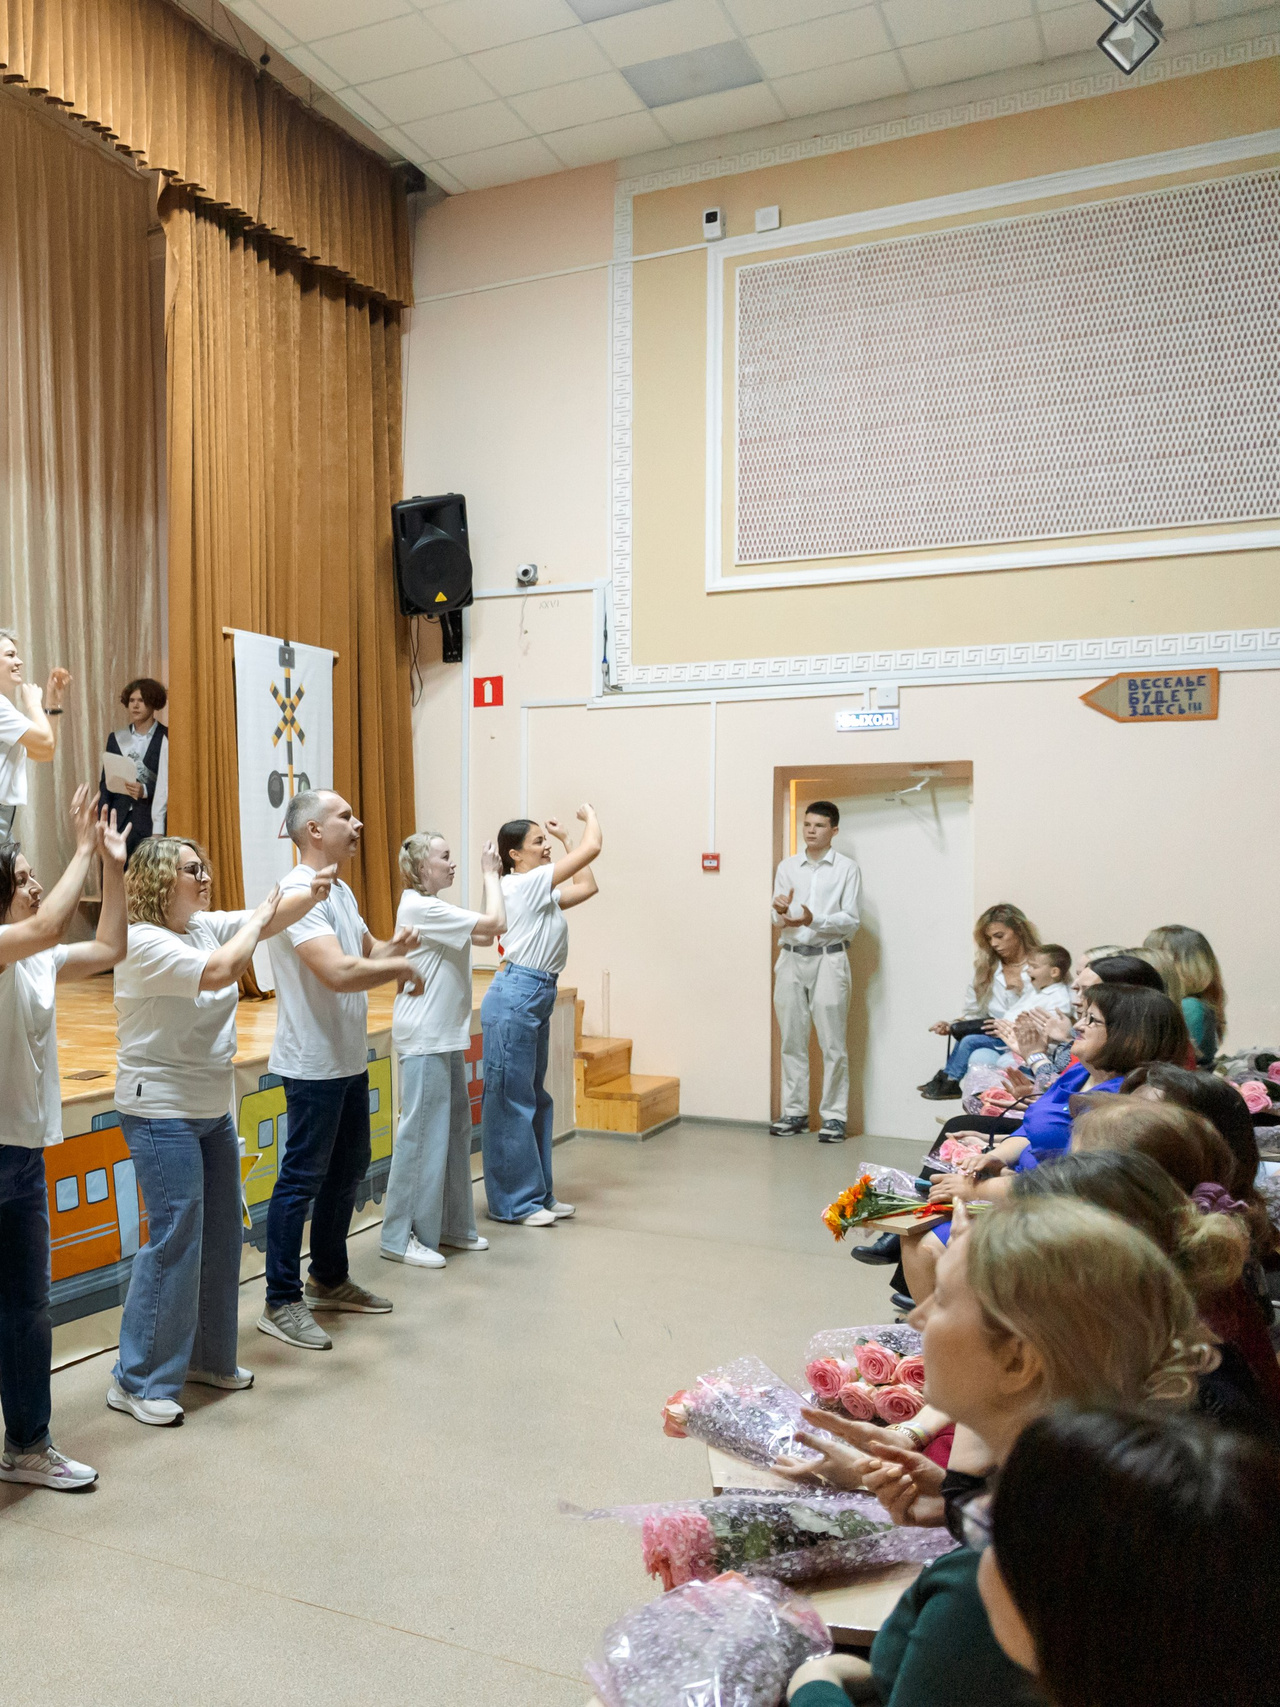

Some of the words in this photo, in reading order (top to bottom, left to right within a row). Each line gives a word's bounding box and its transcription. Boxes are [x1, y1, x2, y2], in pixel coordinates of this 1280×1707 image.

[1128, 675, 1207, 691] ВЕСЕЛЬЕ
[1128, 688, 1198, 705] БУДЕТ
[1129, 702, 1203, 717] ЗДЕСЬ!!!
[840, 712, 895, 728] ВЫХОД
